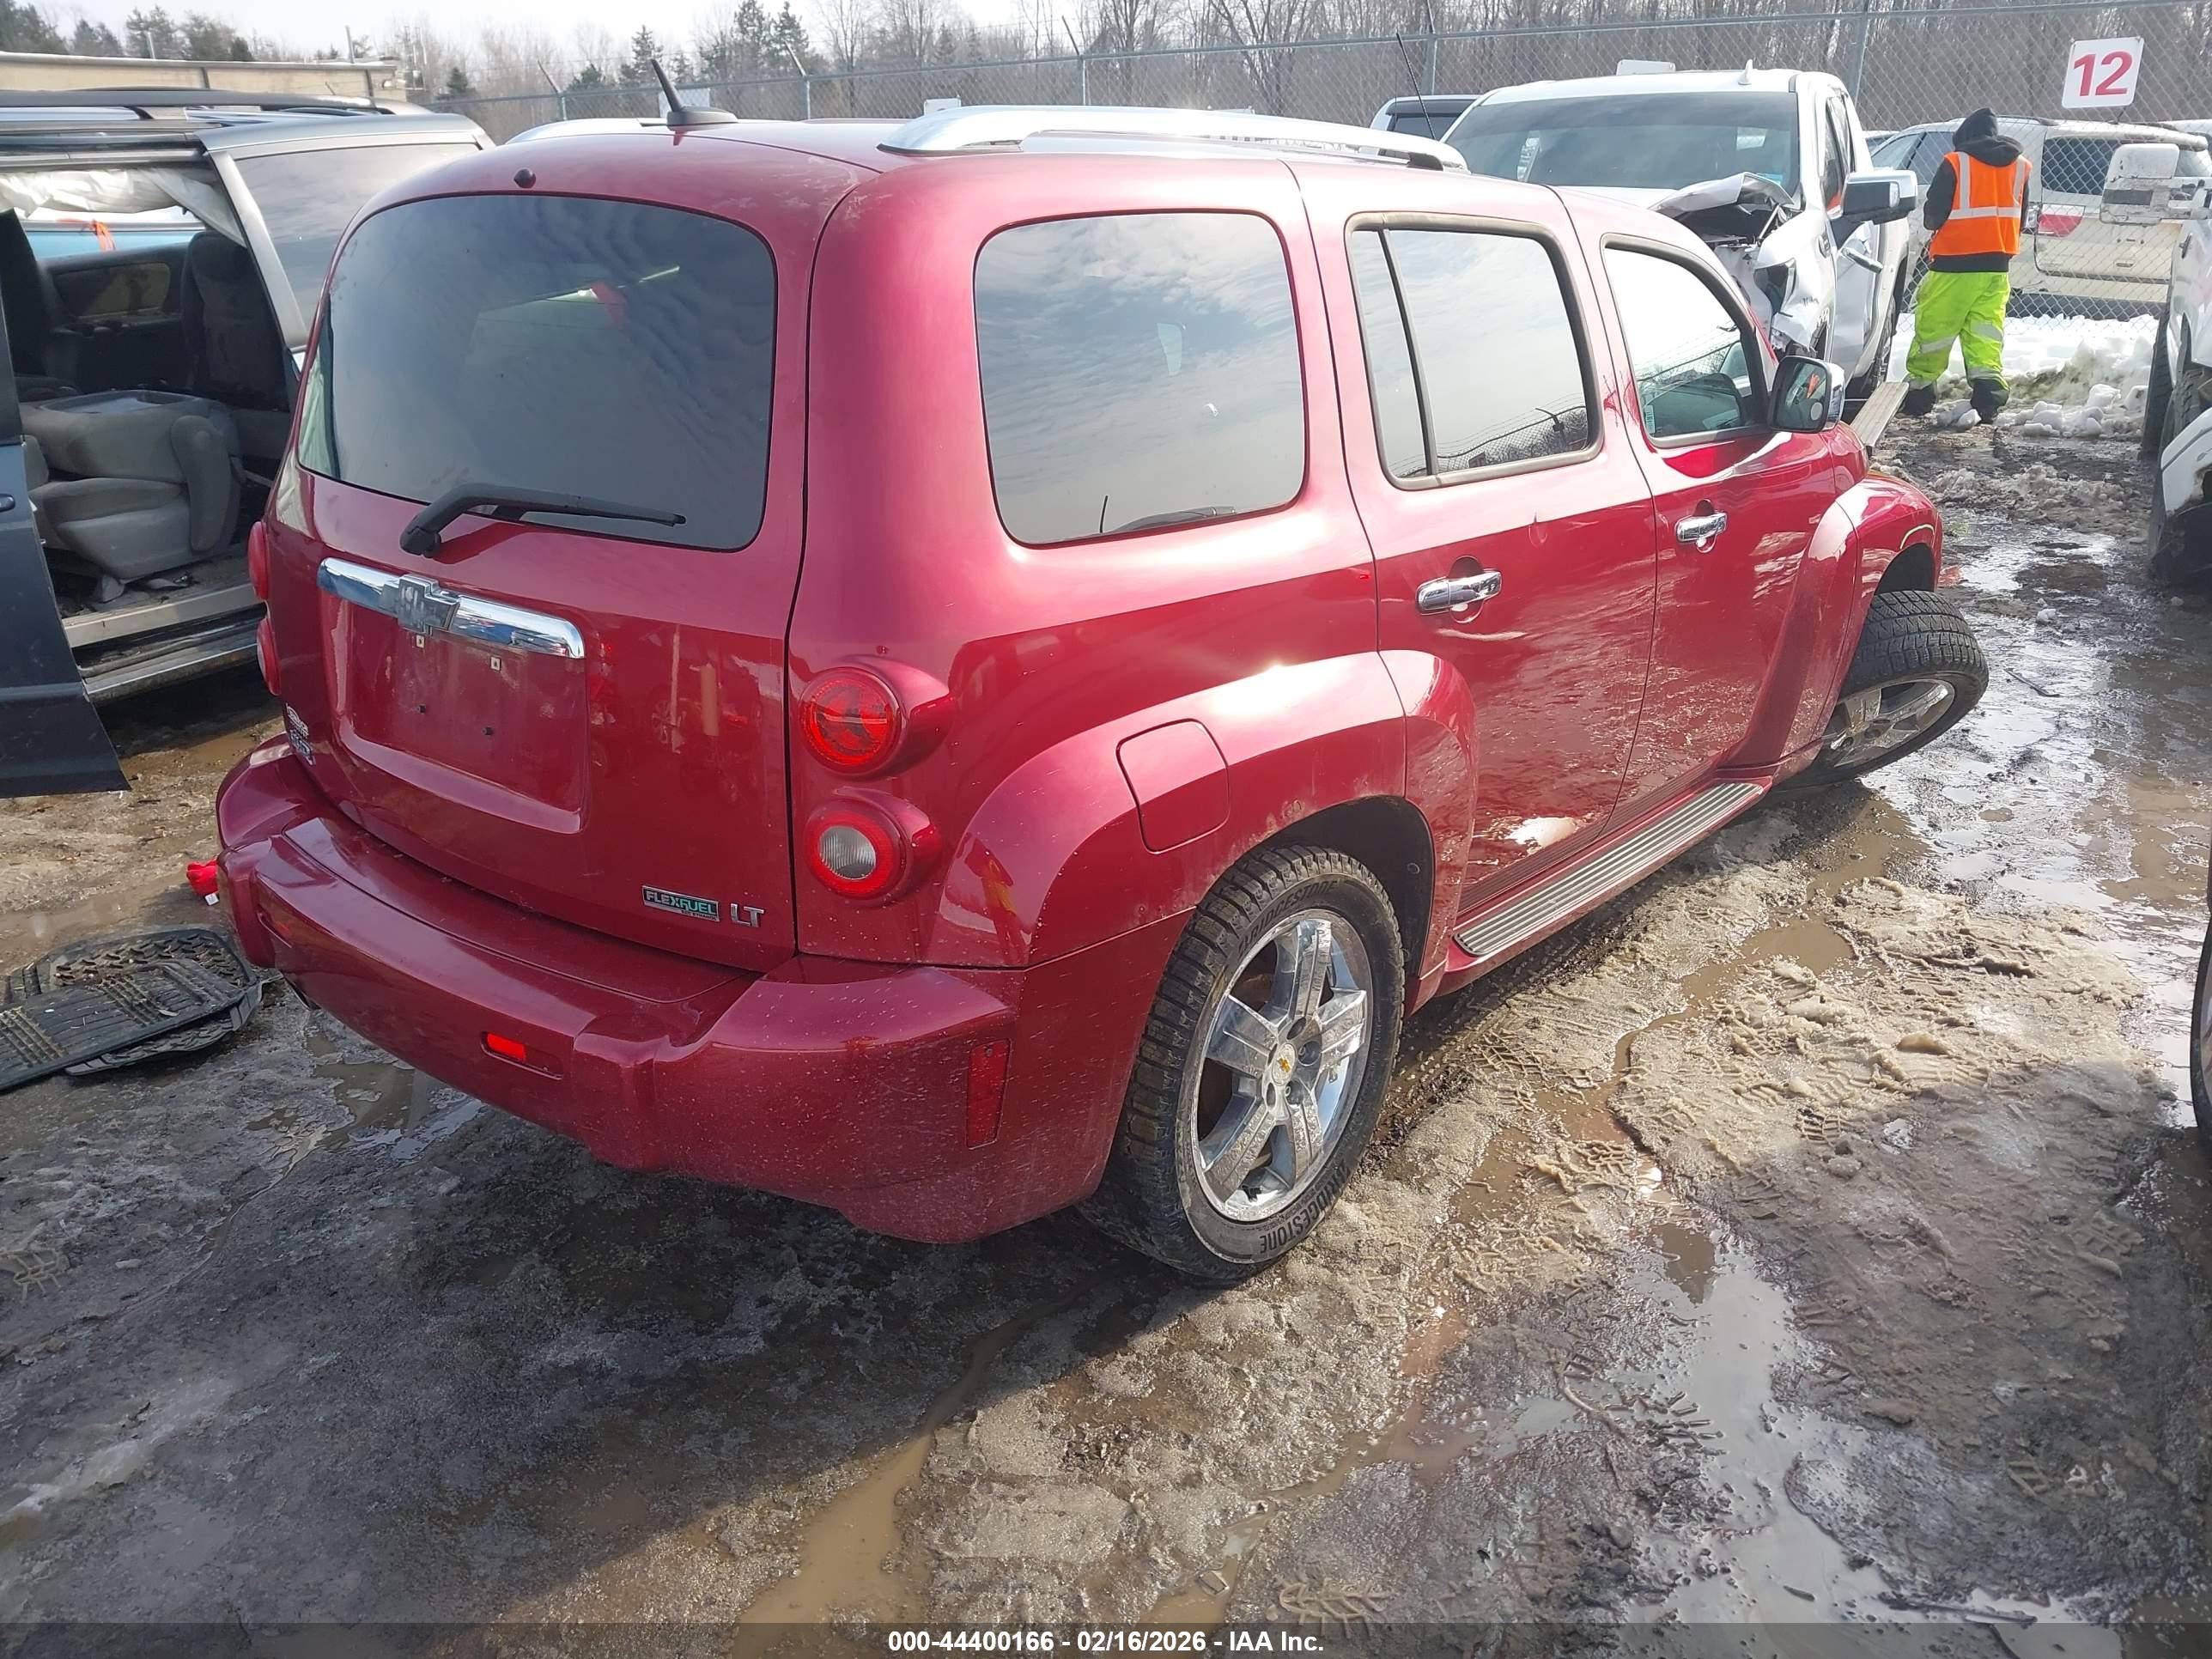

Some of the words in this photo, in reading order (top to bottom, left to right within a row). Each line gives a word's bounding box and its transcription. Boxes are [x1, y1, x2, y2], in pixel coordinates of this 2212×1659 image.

[2074, 52, 2133, 96] 12
[646, 890, 716, 915] FLEXFUEL
[731, 902, 764, 927] LT
